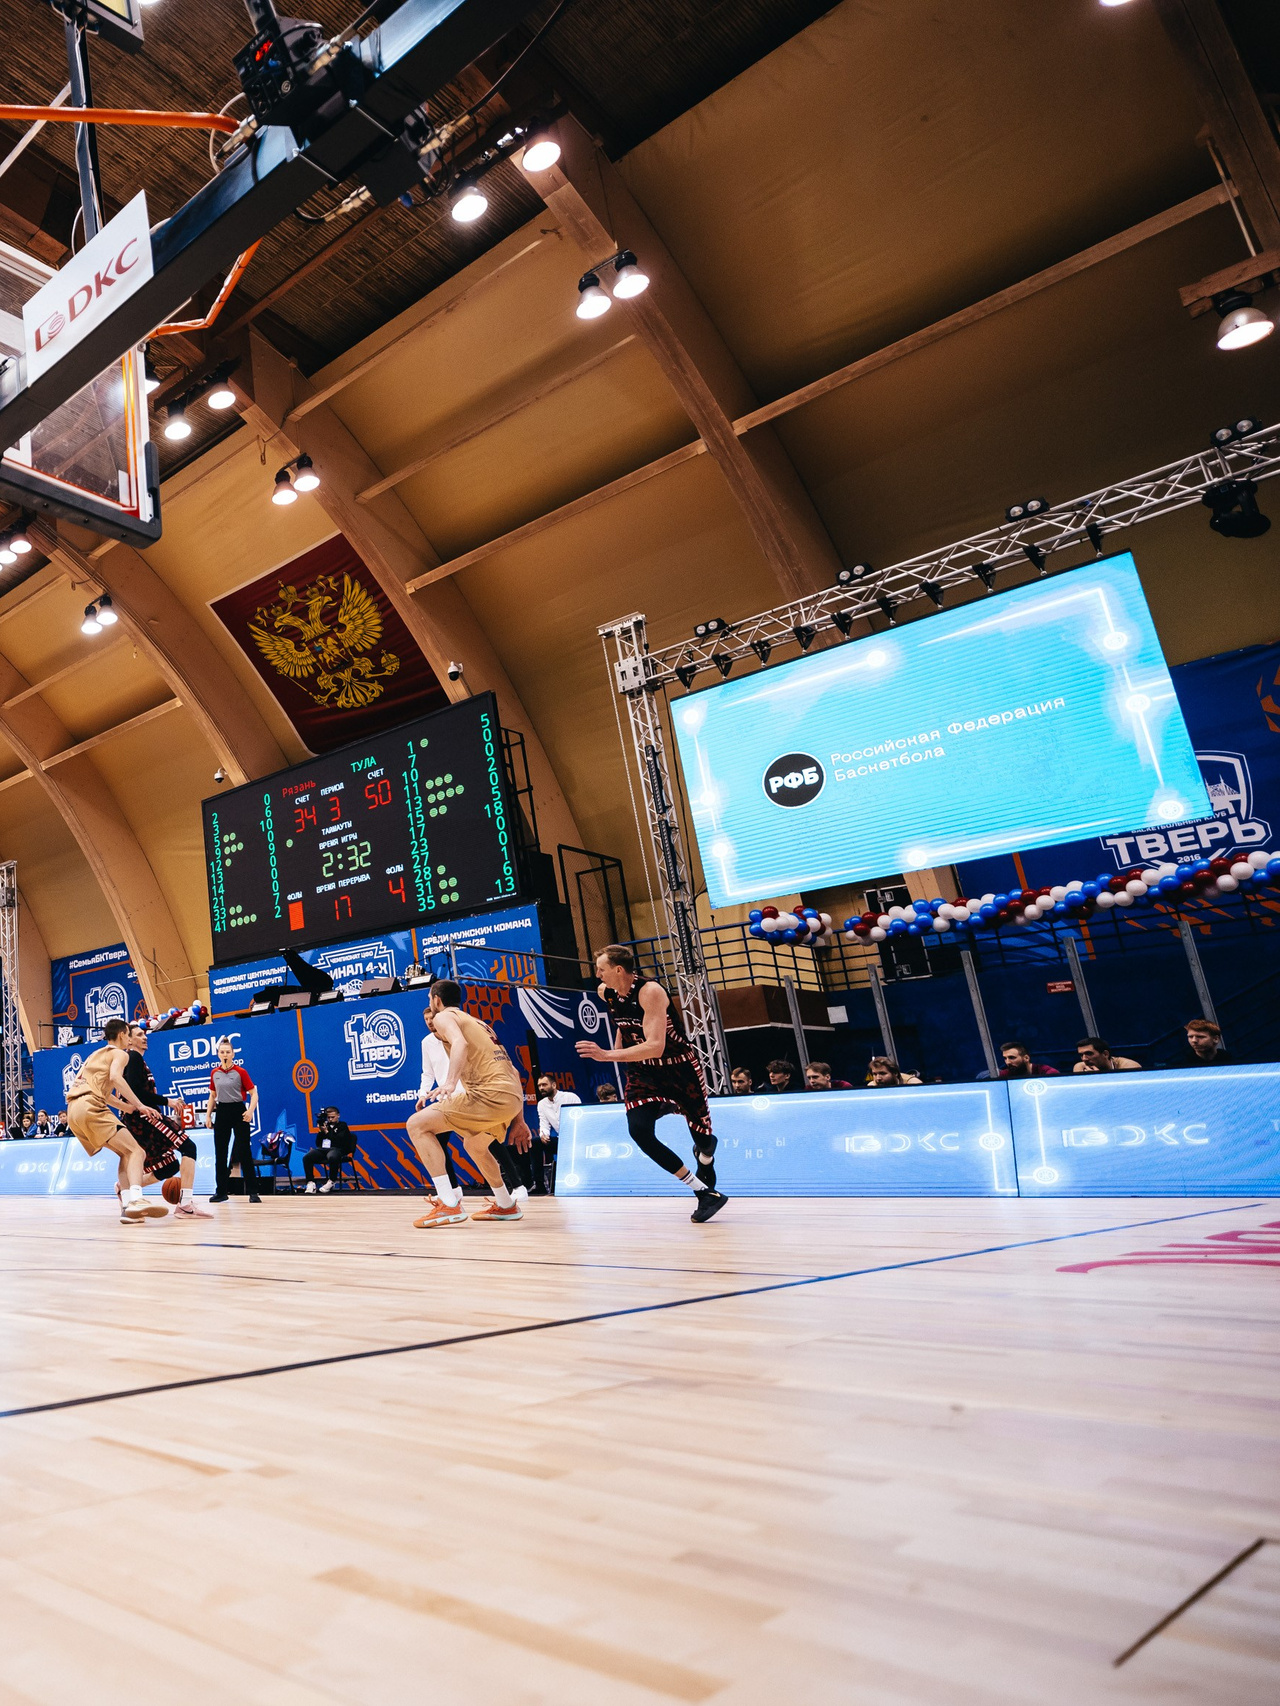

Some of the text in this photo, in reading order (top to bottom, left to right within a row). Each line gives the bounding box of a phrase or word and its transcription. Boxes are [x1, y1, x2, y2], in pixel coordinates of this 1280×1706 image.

[68, 237, 139, 323] DKC
[480, 713, 490, 729] 5
[483, 728, 492, 742] 0
[830, 696, 1065, 766] Российская Федерация
[407, 741, 414, 754] 1
[485, 742, 494, 757] 0
[350, 756, 377, 773] ТУЛА
[408, 754, 416, 768] 7
[486, 757, 497, 772] 2
[834, 746, 945, 782] Баскетбола
[367, 768, 385, 780] СЧЕТ
[402, 768, 419, 785] 10
[489, 771, 498, 786] 0
[769, 766, 820, 794] РФБ
[282, 780, 317, 798] Рязань
[320, 782, 345, 796] ПЕРИОД
[364, 779, 392, 810] 50
[403, 782, 419, 798] 11
[491, 786, 501, 801] 5
[264, 794, 271, 806] 0
[295, 794, 310, 805] СЧЕТ
[405, 796, 422, 812] 13
[265, 806, 272, 818] 6
[328, 796, 341, 822] 3
[484, 801, 503, 819] 18
[212, 813, 218, 825] 2
[259, 818, 273, 832] 10
[294, 805, 317, 833] 34
[407, 810, 424, 826] 15
[496, 816, 505, 830] 0
[213, 825, 220, 836] 3
[321, 820, 353, 836] ТАЙМАУТЫ
[409, 824, 426, 840] 17
[214, 836, 220, 848] 5
[267, 831, 275, 843] 0
[318, 832, 358, 850] ВРЕМЯ ИГРЫ
[498, 831, 508, 845] 0
[1106, 816, 1267, 865] ТВЕРЬ
[269, 843, 276, 855] 9
[410, 838, 428, 854] 23
[501, 846, 508, 860] 1
[215, 849, 222, 860] 9
[270, 855, 277, 867] 0
[322, 841, 372, 878] 2:32
[412, 852, 429, 869] 27
[1176, 853, 1202, 864] 2016
[210, 860, 222, 873] 12
[271, 867, 278, 880] 0
[385, 864, 404, 875] ФОЛЫ
[503, 861, 513, 876] 6
[211, 872, 224, 885] 13
[413, 866, 432, 883] 28
[212, 884, 225, 897] 14
[272, 880, 279, 892] 0
[316, 873, 371, 894] ВРЕМЯ ПЕРЕРЫВА
[388, 876, 406, 903] 4
[415, 881, 433, 897] 31
[495, 877, 515, 894] 13
[213, 896, 225, 909] 21
[273, 893, 280, 906] 7
[287, 891, 303, 901] ФОЛЫ
[417, 895, 436, 912] 35
[213, 908, 227, 922] 33
[274, 905, 282, 919] 2
[334, 895, 352, 920] 17
[214, 920, 227, 933] 41
[422, 918, 532, 946] СРЕДИ МУЖСКИХ КОМАНД
[69, 950, 128, 969] #СемьяБКТверь
[329, 953, 361, 964] ЧЕМПИОНАТ
[328, 962, 363, 980] ИНАЛ
[213, 973, 247, 986] ЧЕМПИОНАТ
[213, 976, 283, 995] ФЕДЕРАЛЬНОГО ОКРУГА
[361, 1046, 401, 1062] ТВЕРЬ
[171, 1061, 210, 1074] Титульный
[183, 1109, 193, 1124] 5
